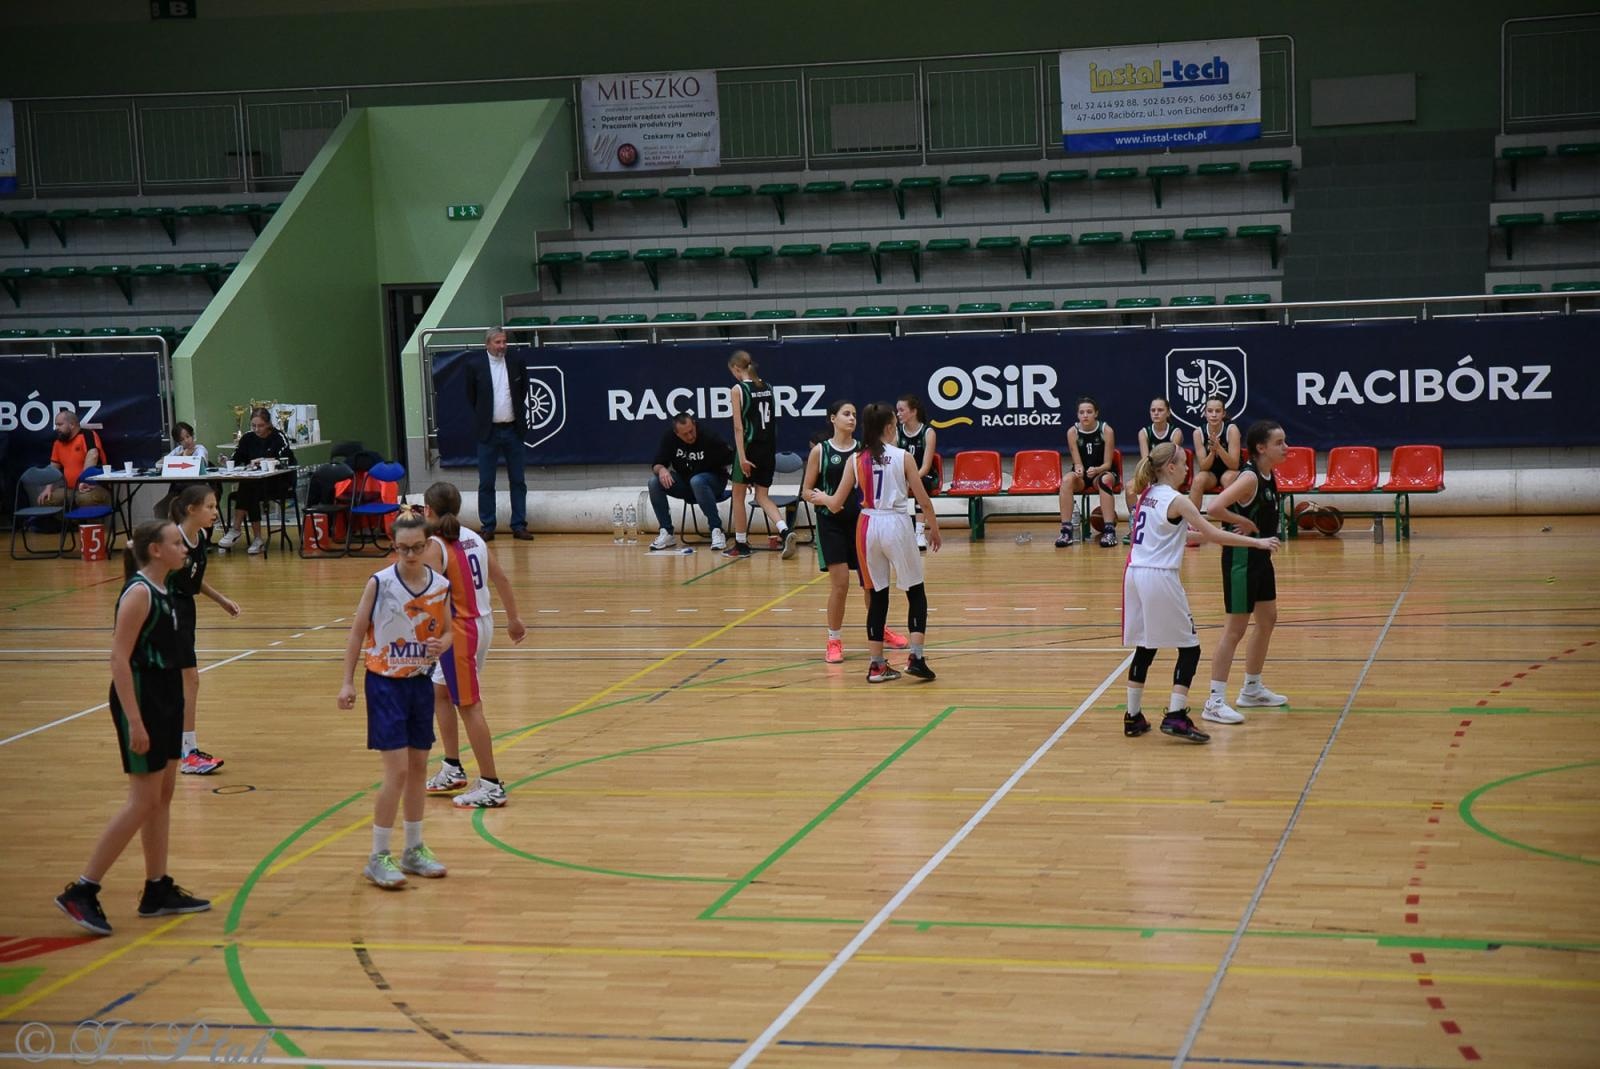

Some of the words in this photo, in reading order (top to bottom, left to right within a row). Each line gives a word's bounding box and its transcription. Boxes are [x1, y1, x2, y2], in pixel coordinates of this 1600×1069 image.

[169, 0, 188, 16] B
[1089, 56, 1230, 93] instal-tech
[598, 76, 701, 101] MIESZKO
[1070, 102, 1082, 111] tel.
[1085, 102, 1095, 110] 32
[1097, 101, 1113, 110] 414
[1114, 99, 1125, 108] 92
[1143, 97, 1158, 106] 502
[1160, 96, 1175, 105] 632
[1199, 94, 1216, 102] 606
[1235, 91, 1252, 101] 647
[1076, 111, 1107, 122] 47-400
[1147, 108, 1158, 118] ul.
[1167, 108, 1183, 117] von
[1185, 103, 1239, 115] Eichendorffa
[1241, 103, 1246, 112] 2
[601, 114, 632, 123] Operator
[667, 110, 715, 119] cukierniczych
[601, 122, 638, 130] Pracownik
[640, 120, 683, 129] produkcyjny
[643, 132, 674, 141] Czekamy
[1115, 130, 1207, 145] www.instal-tech.pl
[928, 365, 1061, 410] OSiR
[1296, 355, 1553, 406] RACIBÓRZ
[0, 390, 103, 431] BÓZ
[607, 385, 827, 421] RACIBRZ
[981, 410, 1061, 427] RACIBÓRZ
[873, 469, 884, 500] 7
[89, 529, 102, 552] 5
[309, 518, 324, 541] 5
[468, 553, 484, 590] 9
